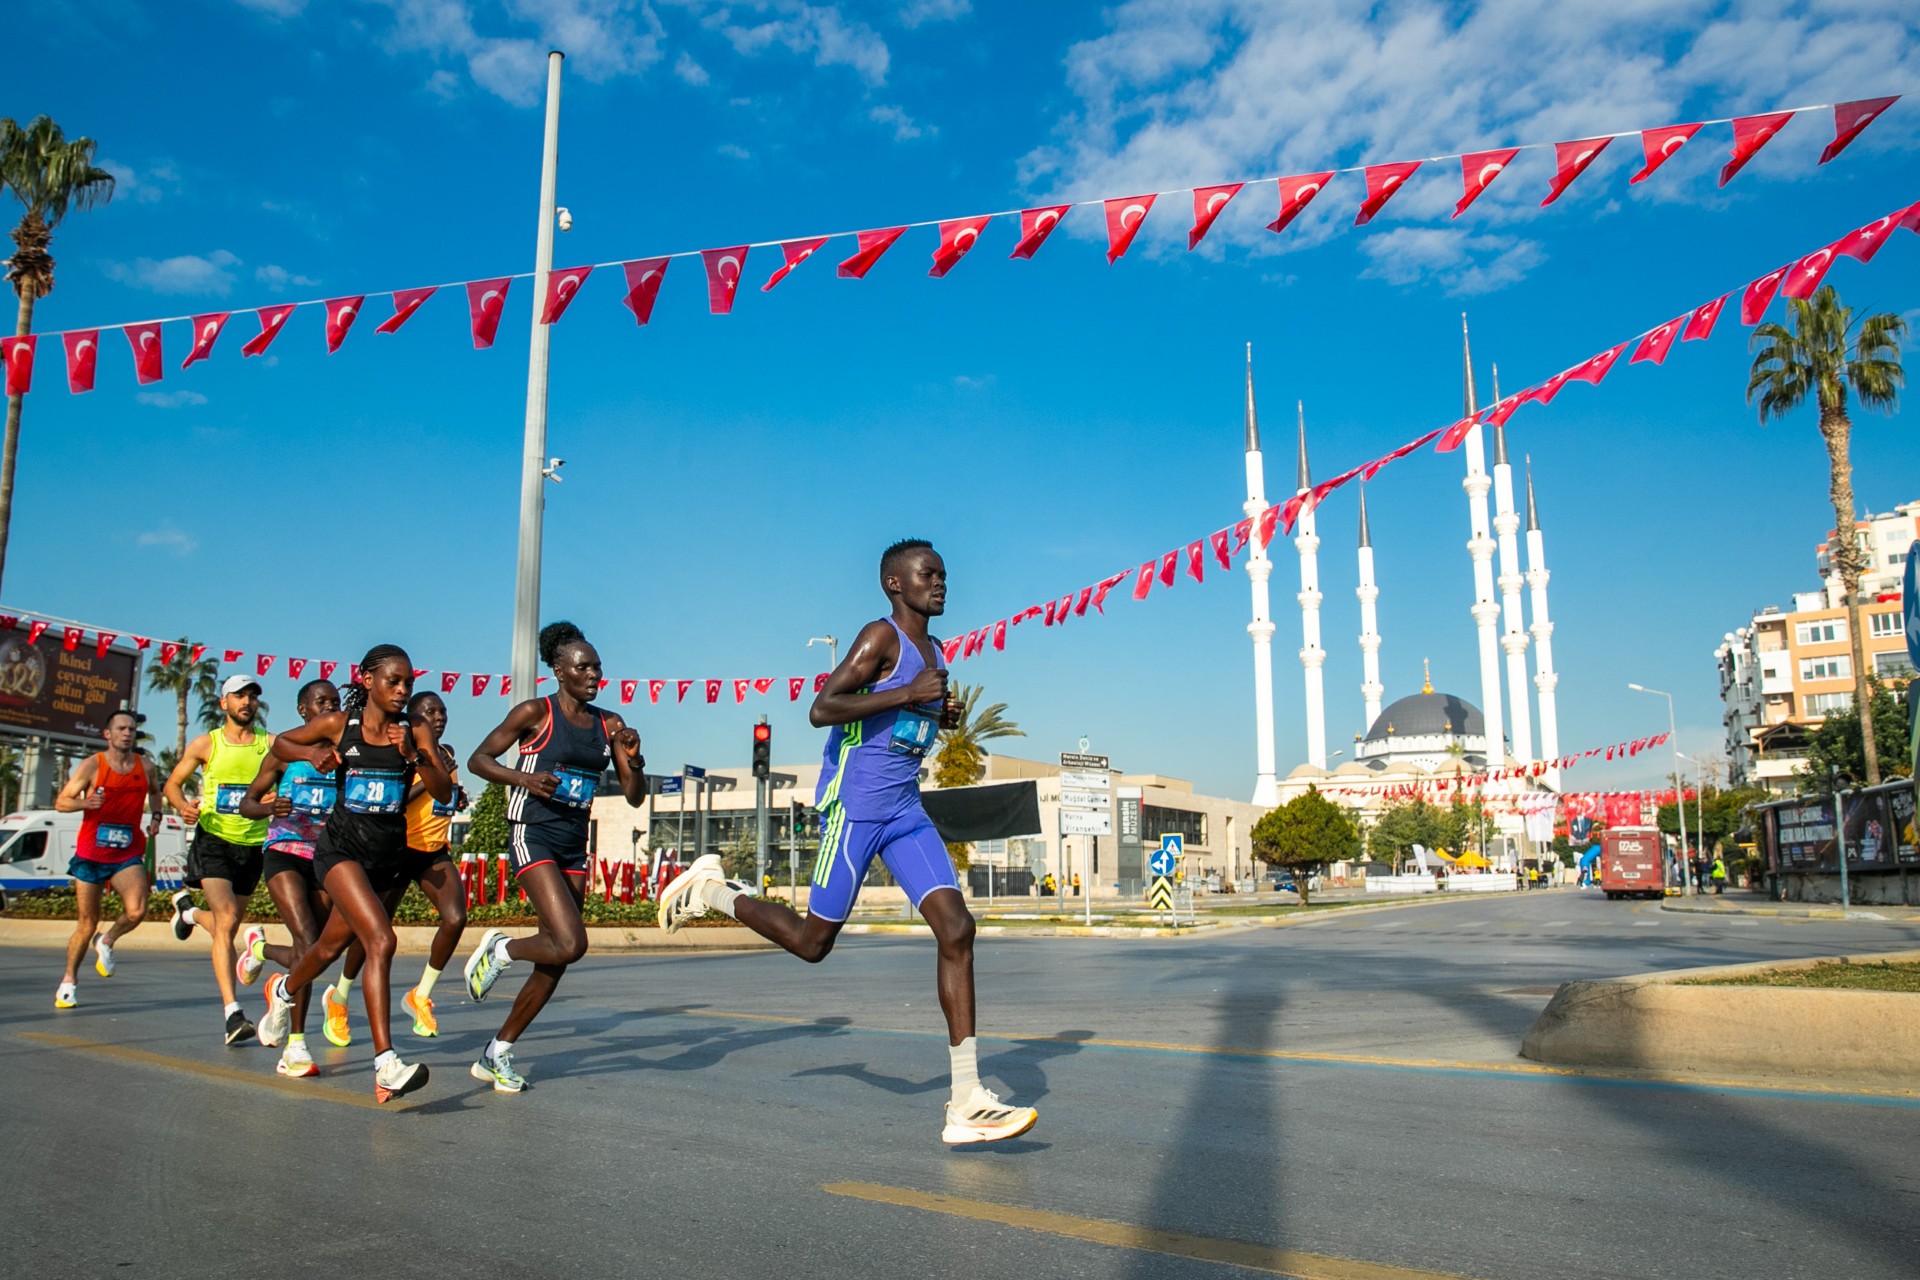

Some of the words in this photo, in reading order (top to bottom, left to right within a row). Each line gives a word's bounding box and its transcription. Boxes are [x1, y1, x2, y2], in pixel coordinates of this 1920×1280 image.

[84, 690, 106, 704] gibi
[53, 698, 84, 715] olsun
[310, 788, 324, 805] 21
[367, 781, 385, 801] 28
